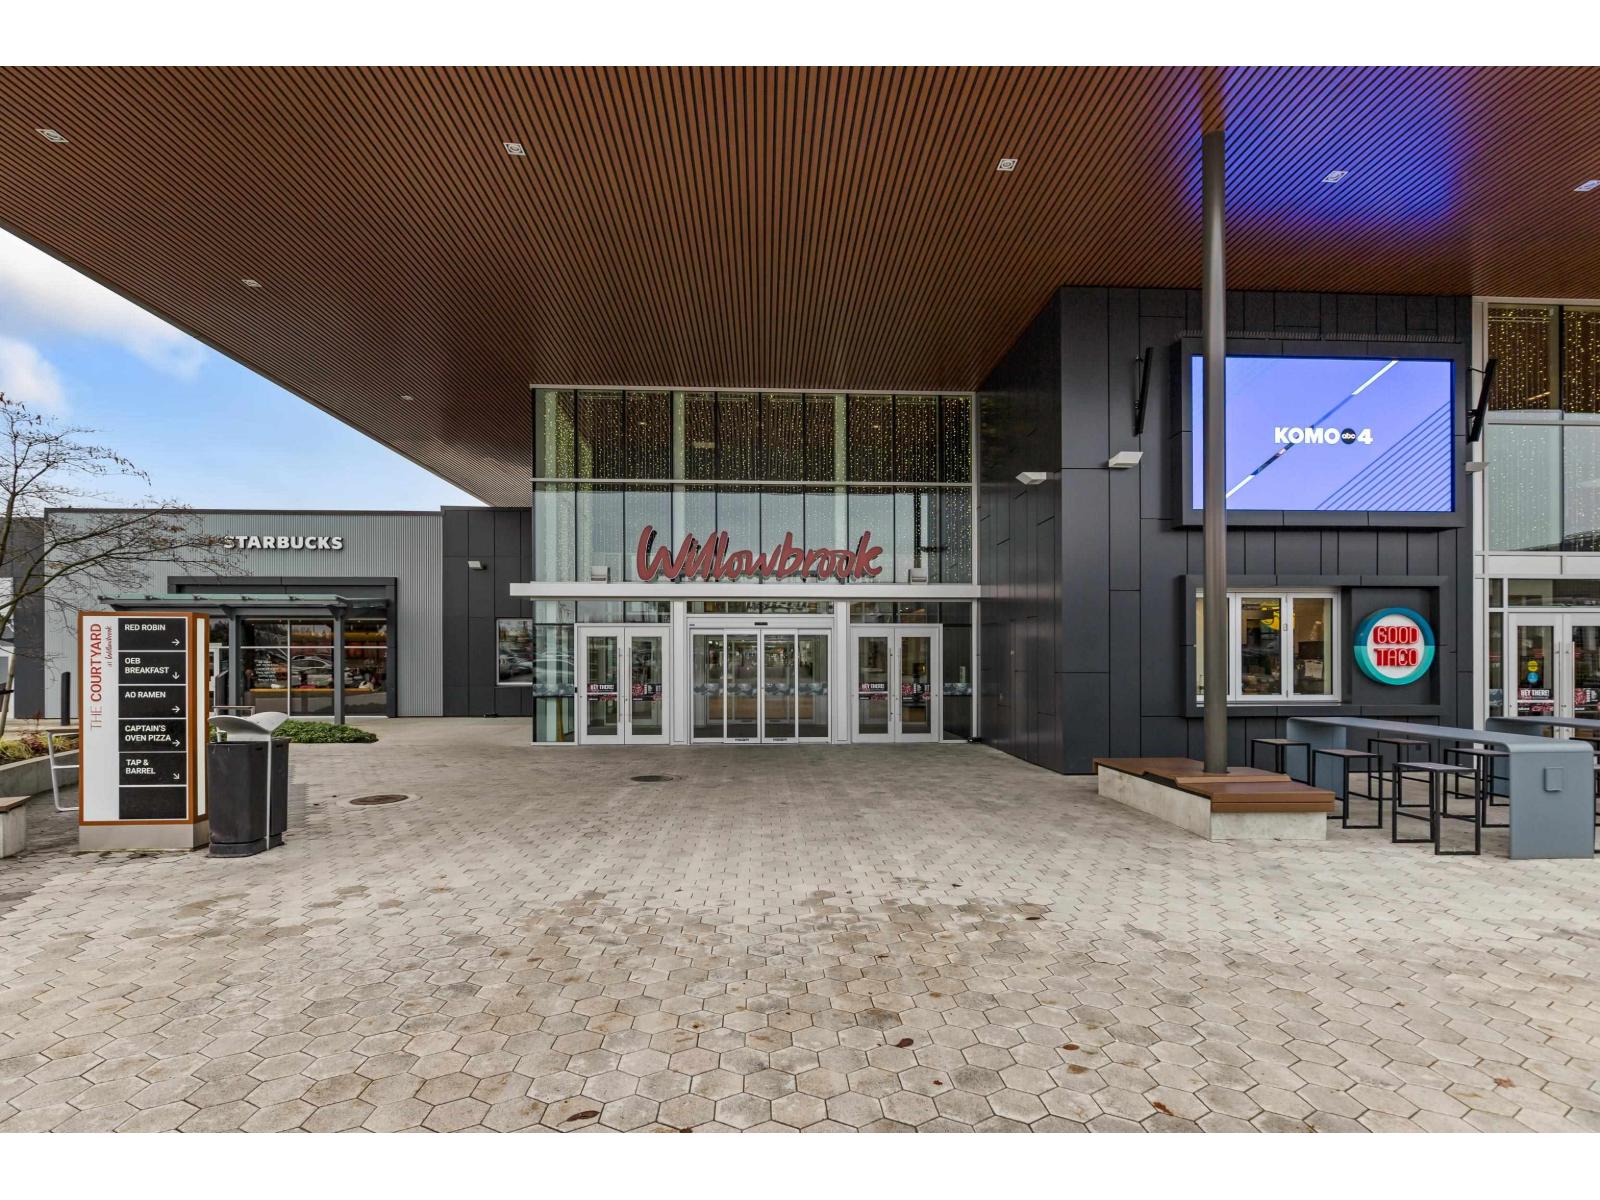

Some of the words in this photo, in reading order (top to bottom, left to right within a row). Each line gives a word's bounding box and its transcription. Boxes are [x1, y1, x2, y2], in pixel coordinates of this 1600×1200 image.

[1274, 427, 1340, 444] KOMO
[1341, 432, 1356, 440] abc
[1357, 428, 1373, 445] 4
[223, 535, 344, 550] STARBUCKS
[637, 525, 883, 581] Willowbrook
[1373, 626, 1419, 644] GOOD
[90, 623, 102, 702] COURTYARD
[1374, 648, 1418, 667] TACO
[124, 666, 170, 674] BREAKFAST
[90, 706, 102, 731] THE
[124, 734, 147, 742] OVEN
[148, 734, 172, 742] PIZZA
